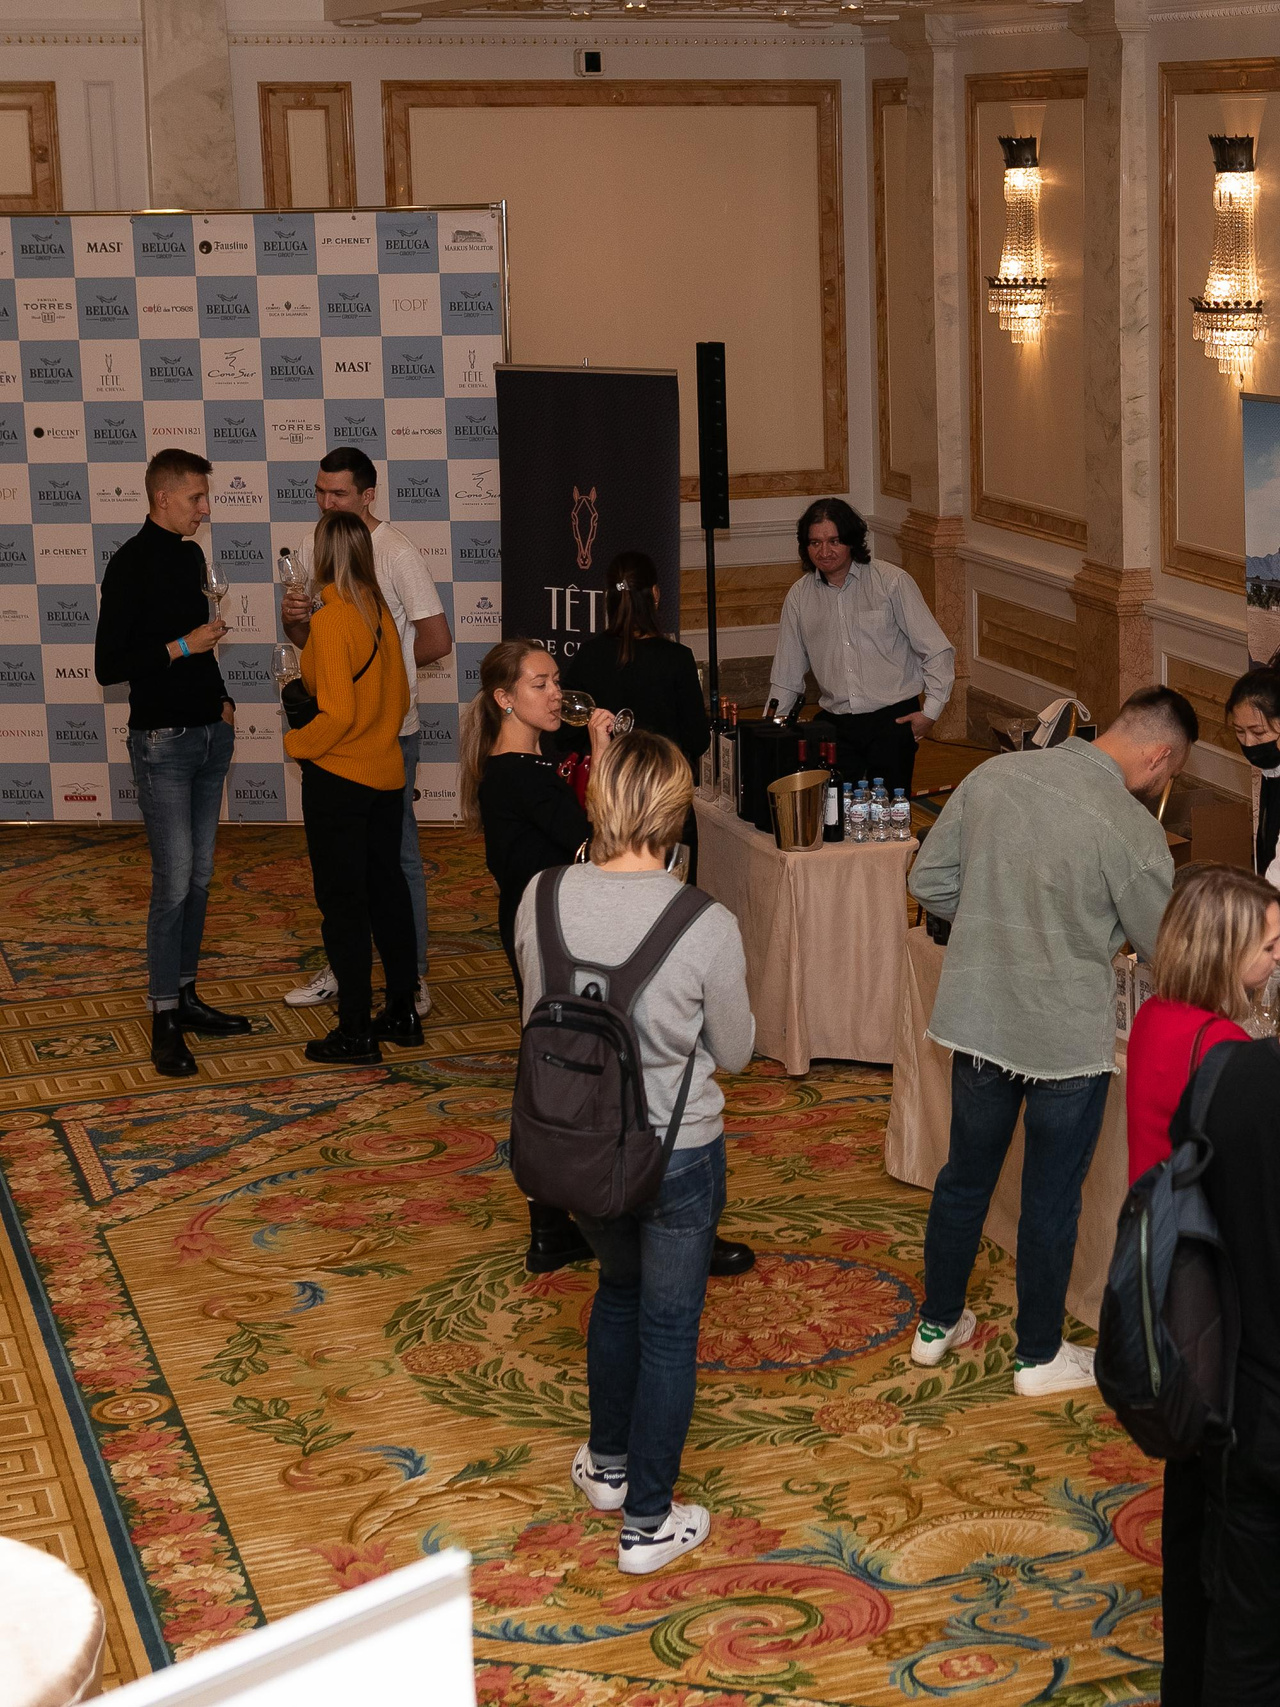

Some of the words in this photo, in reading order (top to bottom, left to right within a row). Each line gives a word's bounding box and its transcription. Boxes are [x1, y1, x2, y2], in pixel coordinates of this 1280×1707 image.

[21, 244, 65, 254] BELUGA
[87, 242, 122, 252] MASI
[142, 243, 186, 252] BELUGA
[214, 241, 248, 251] Faustino
[264, 241, 308, 251] BELUGA
[386, 240, 429, 249] BELUGA
[85, 306, 129, 315] BELUGA
[206, 304, 250, 314] BELUGA
[328, 303, 371, 312] BELUGA
[449, 302, 493, 311] BELUGA
[150, 367, 193, 376] BELUGA
[270, 366, 314, 375] BELUGA
[335, 362, 371, 372] MASI
[391, 365, 435, 374] BELUGA
[30, 368, 73, 378] BELUGA
[94, 429, 137, 438] BELUGA
[214, 428, 257, 437] BELUGA
[334, 427, 378, 436] BELUGA
[420, 427, 442, 435] roses
[455, 425, 498, 435] BELUGA
[39, 491, 81, 500] BELUGA
[397, 488, 441, 497] BELUGA
[214, 495, 263, 504] POMMERY
[0, 551, 27, 561] LUGA
[221, 550, 264, 559] BELUGA
[544, 584, 603, 633] TÊT
[47, 612, 90, 621] BELUGA
[460, 616, 501, 624] POMMER
[0, 672, 35, 681] ELUGA
[56, 668, 90, 678] MASI
[228, 671, 270, 680] BELUGA
[56, 731, 98, 740] BELUGA
[418, 731, 451, 740] ELUGA
[2, 790, 44, 799] BELUGA
[118, 790, 138, 799] BEL
[235, 790, 278, 799] BELUGA
[423, 789, 456, 799] Faustino
